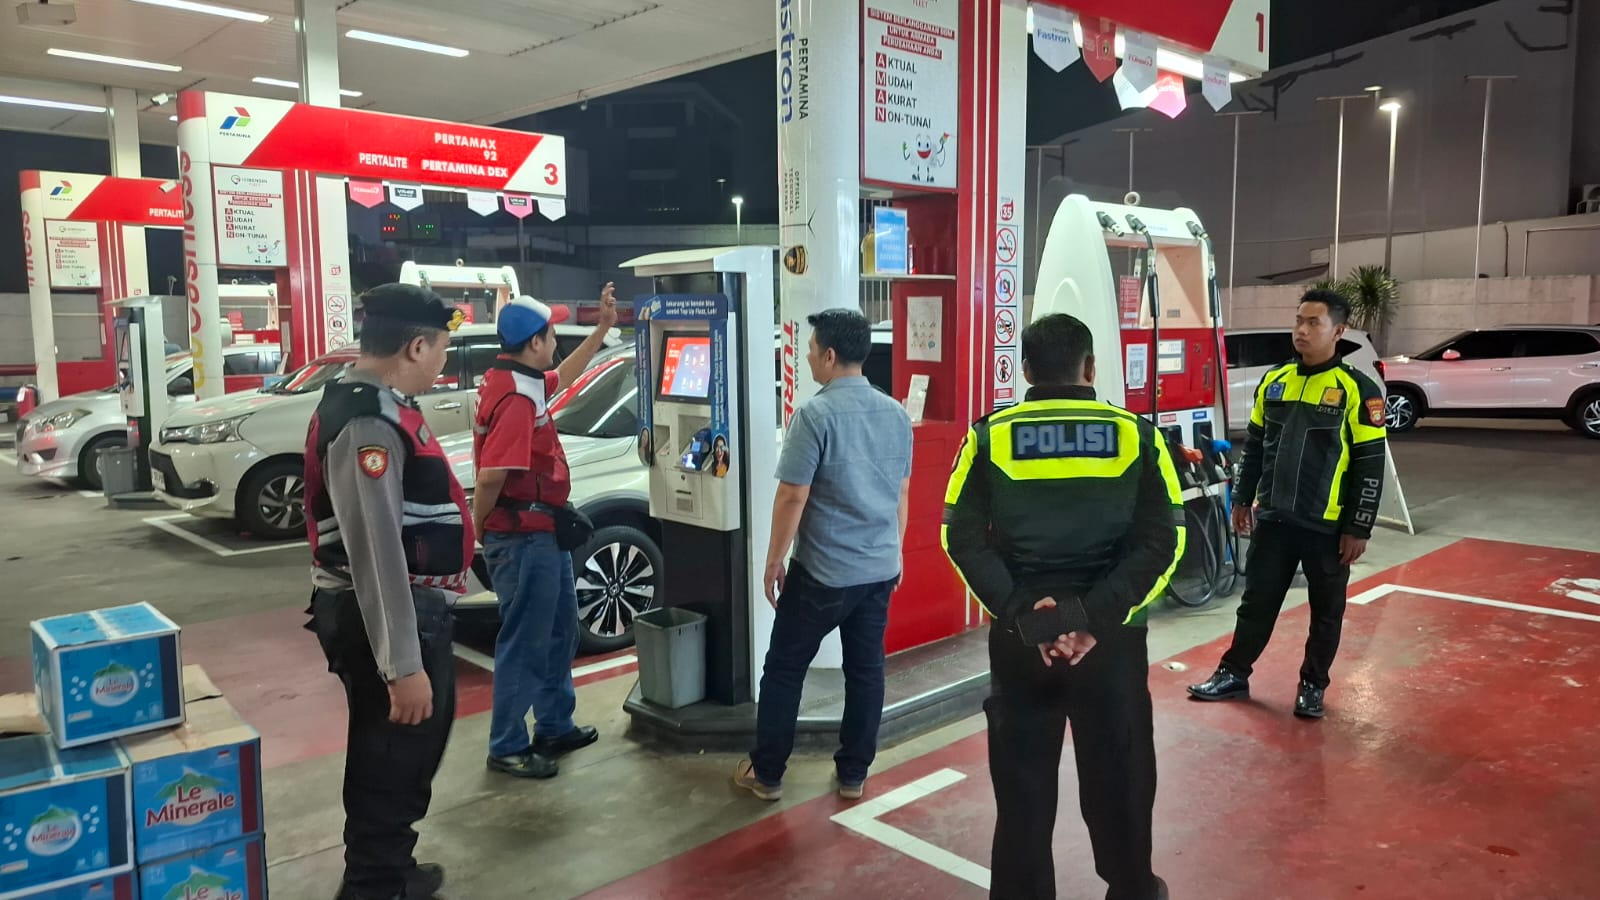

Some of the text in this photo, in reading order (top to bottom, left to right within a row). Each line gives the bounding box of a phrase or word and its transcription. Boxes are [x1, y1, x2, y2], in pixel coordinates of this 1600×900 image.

[870, 7, 892, 21] SISTEM
[893, 13, 940, 35] BERLANGGANAN
[889, 25, 935, 44] UNTUK ARMADA
[1037, 28, 1071, 44] Fastron
[1256, 12, 1264, 53] 1
[883, 36, 923, 52] PERUSAHAAN
[798, 38, 809, 120] PERTAMINA
[434, 132, 496, 150] PERTAMAX
[359, 152, 408, 169] PERTALITE
[483, 150, 497, 161] 92
[421, 159, 508, 178] PERTAMINA DEX
[544, 163, 558, 186] 3
[1017, 423, 1114, 455] POLISI
[1353, 477, 1379, 527] POLISI
[177, 784, 202, 803] Le
[146, 791, 235, 828] Minerale
